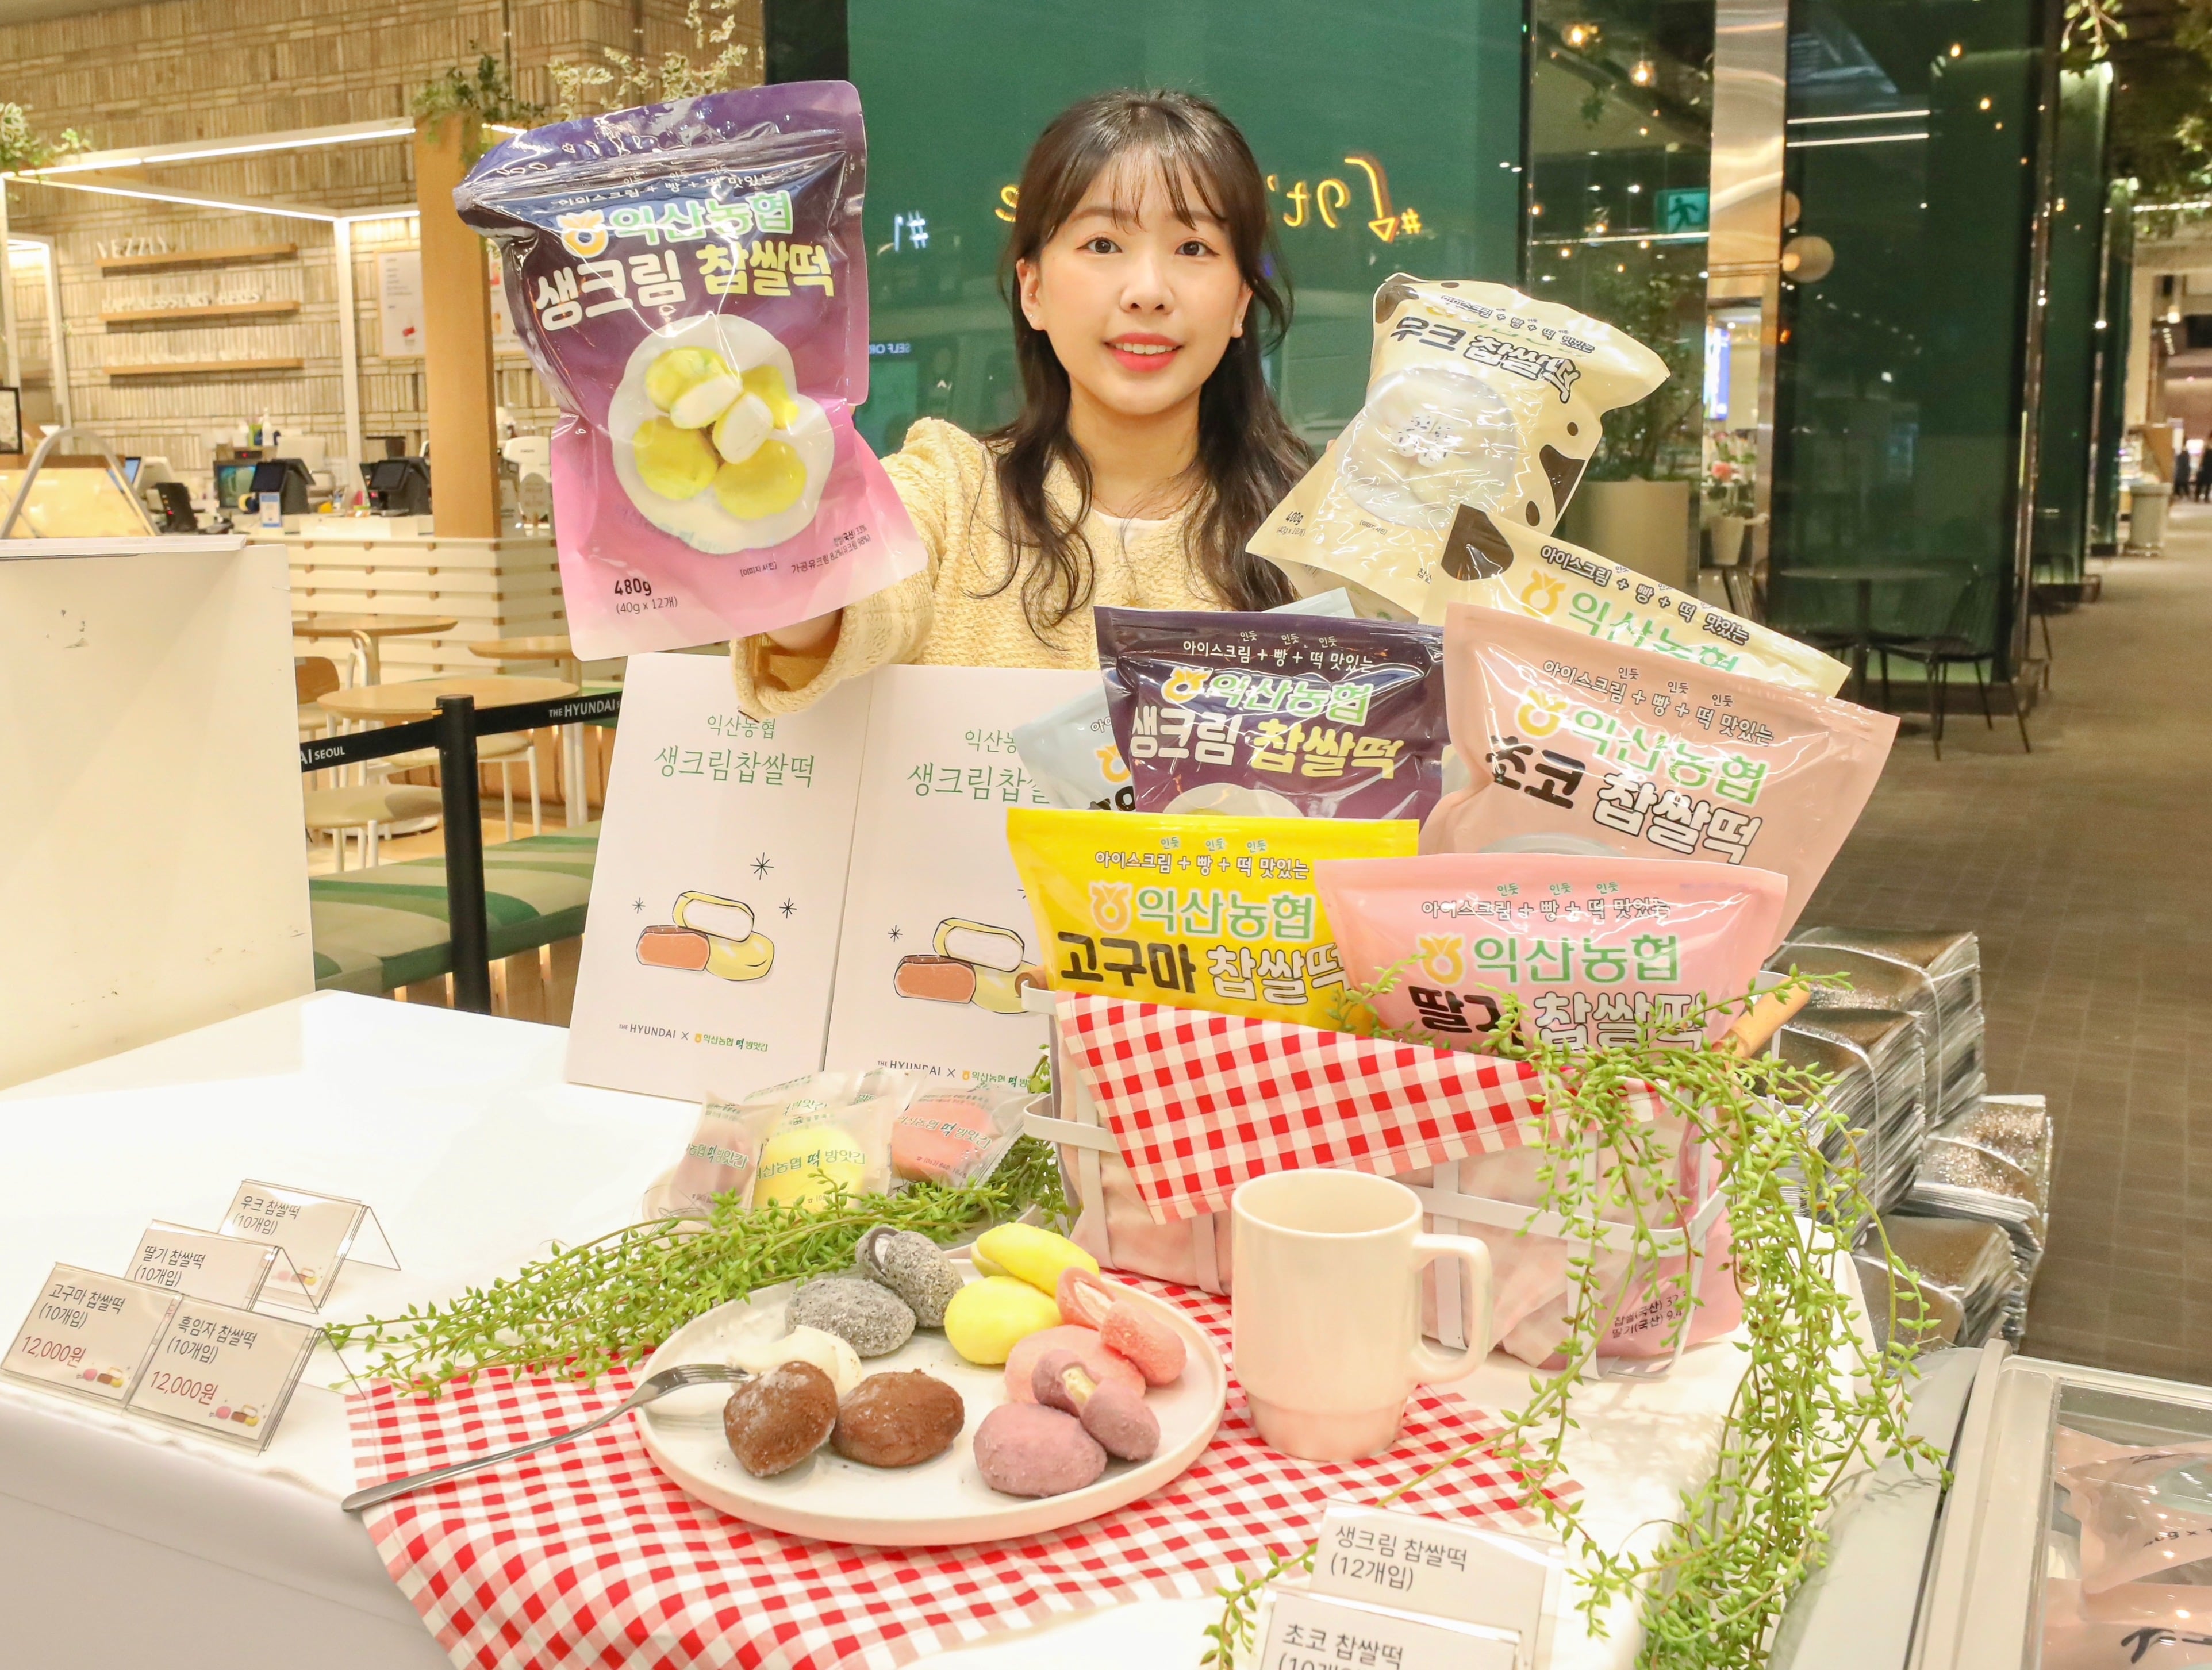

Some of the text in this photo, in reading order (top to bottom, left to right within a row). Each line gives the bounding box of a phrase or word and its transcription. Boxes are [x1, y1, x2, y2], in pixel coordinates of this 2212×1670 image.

[665, 181, 681, 193] 빵
[609, 190, 793, 246] 익산농협
[535, 240, 835, 332] 생크림 찹쌀떡
[1390, 316, 1466, 351] 우크
[1510, 317, 1525, 329] 빵
[1541, 327, 1557, 340] 떡
[1560, 334, 1596, 354] 맛있는
[1285, 511, 1304, 526] 400g
[791, 553, 830, 574] 가공유크림
[614, 577, 652, 597] 480g
[1540, 545, 1612, 587] 아이스크림
[1634, 582, 1655, 605] 빵
[1677, 600, 1698, 624] 떡
[1702, 612, 1750, 647] 맛있는
[616, 601, 640, 615] (40g
[652, 595, 678, 610] 12개)
[1239, 630, 1258, 643] 인듯
[1281, 633, 1300, 646] 인듯
[1318, 635, 1338, 648] 인듯
[1182, 640, 1251, 664] 아이스크림
[1273, 648, 1288, 668] 빵
[1309, 651, 1324, 670] 떡
[1330, 653, 1374, 674] 맛있는
[1618, 667, 1640, 681] 인듯
[1209, 673, 1374, 727] 익산농협
[1667, 681, 1689, 695] 인듯
[1711, 694, 1734, 707] 인듯
[549, 708, 563, 717] THE
[564, 699, 616, 718] HYUNDAI
[1543, 660, 1628, 705] 아이스크림
[1652, 694, 1670, 717] 빵
[1695, 706, 1715, 730] 떡
[1719, 715, 1775, 747] 맛있는
[707, 714, 776, 740] 익산농협
[314, 746, 345, 760] SEOUL
[1129, 705, 1405, 779] 생크림 찹쌀떡
[653, 744, 815, 788] 생크림찹쌀떡
[1571, 708, 1769, 808] 익산농협
[1593, 772, 1763, 865] 찹쌀떡
[1160, 836, 1180, 851] 인듯
[1205, 838, 1226, 852] 인듯
[1246, 840, 1266, 854] 인듯
[1095, 851, 1172, 874] 아이스크림
[1196, 855, 1213, 876] 빵
[1236, 856, 1253, 877] 떡
[1259, 857, 1310, 880] 맛있는
[1496, 882, 1519, 897] 인듯
[1549, 882, 1572, 896] 인듯
[1595, 881, 1619, 896] 인듯
[1136, 886, 1315, 942] 익산농협
[1422, 899, 1512, 921] 아이스크림
[1539, 900, 1559, 922] 빵
[1587, 898, 1606, 923] 떡
[1614, 897, 1670, 921] 맛있는
[1057, 931, 1351, 1005] 고구마 찹쌀떡
[1473, 933, 1681, 985] 익산농협
[629, 1023, 677, 1039] HYUNDAI
[735, 1038, 745, 1050] 떡
[1008, 1075, 1018, 1088] 떡
[940, 1122, 957, 1137] 떡
[954, 1127, 993, 1150] 방앗간
[807, 1149, 821, 1168] 떡
[825, 1149, 866, 1166] 방앗간
[241, 1195, 301, 1220] 우크 찹쌀떡
[232, 1212, 278, 1236] (10개입)
[143, 1245, 206, 1270] 딸기 찹쌀떡
[133, 1264, 182, 1288] (10개입)
[48, 1283, 126, 1315] 고구마 찹쌀떡
[39, 1302, 89, 1329] (10개입)
[178, 1315, 258, 1350] 흑임자 찹쌀떡
[22, 1336, 87, 1368] 12,000원
[167, 1336, 219, 1365] (10개입)
[151, 1371, 219, 1406] 12,000원
[1334, 1524, 1468, 1573] 생크림 찹쌀떡
[1329, 1553, 1415, 1592] (12개입)
[1282, 1623, 1403, 1669] 초코 찹쌀떡
